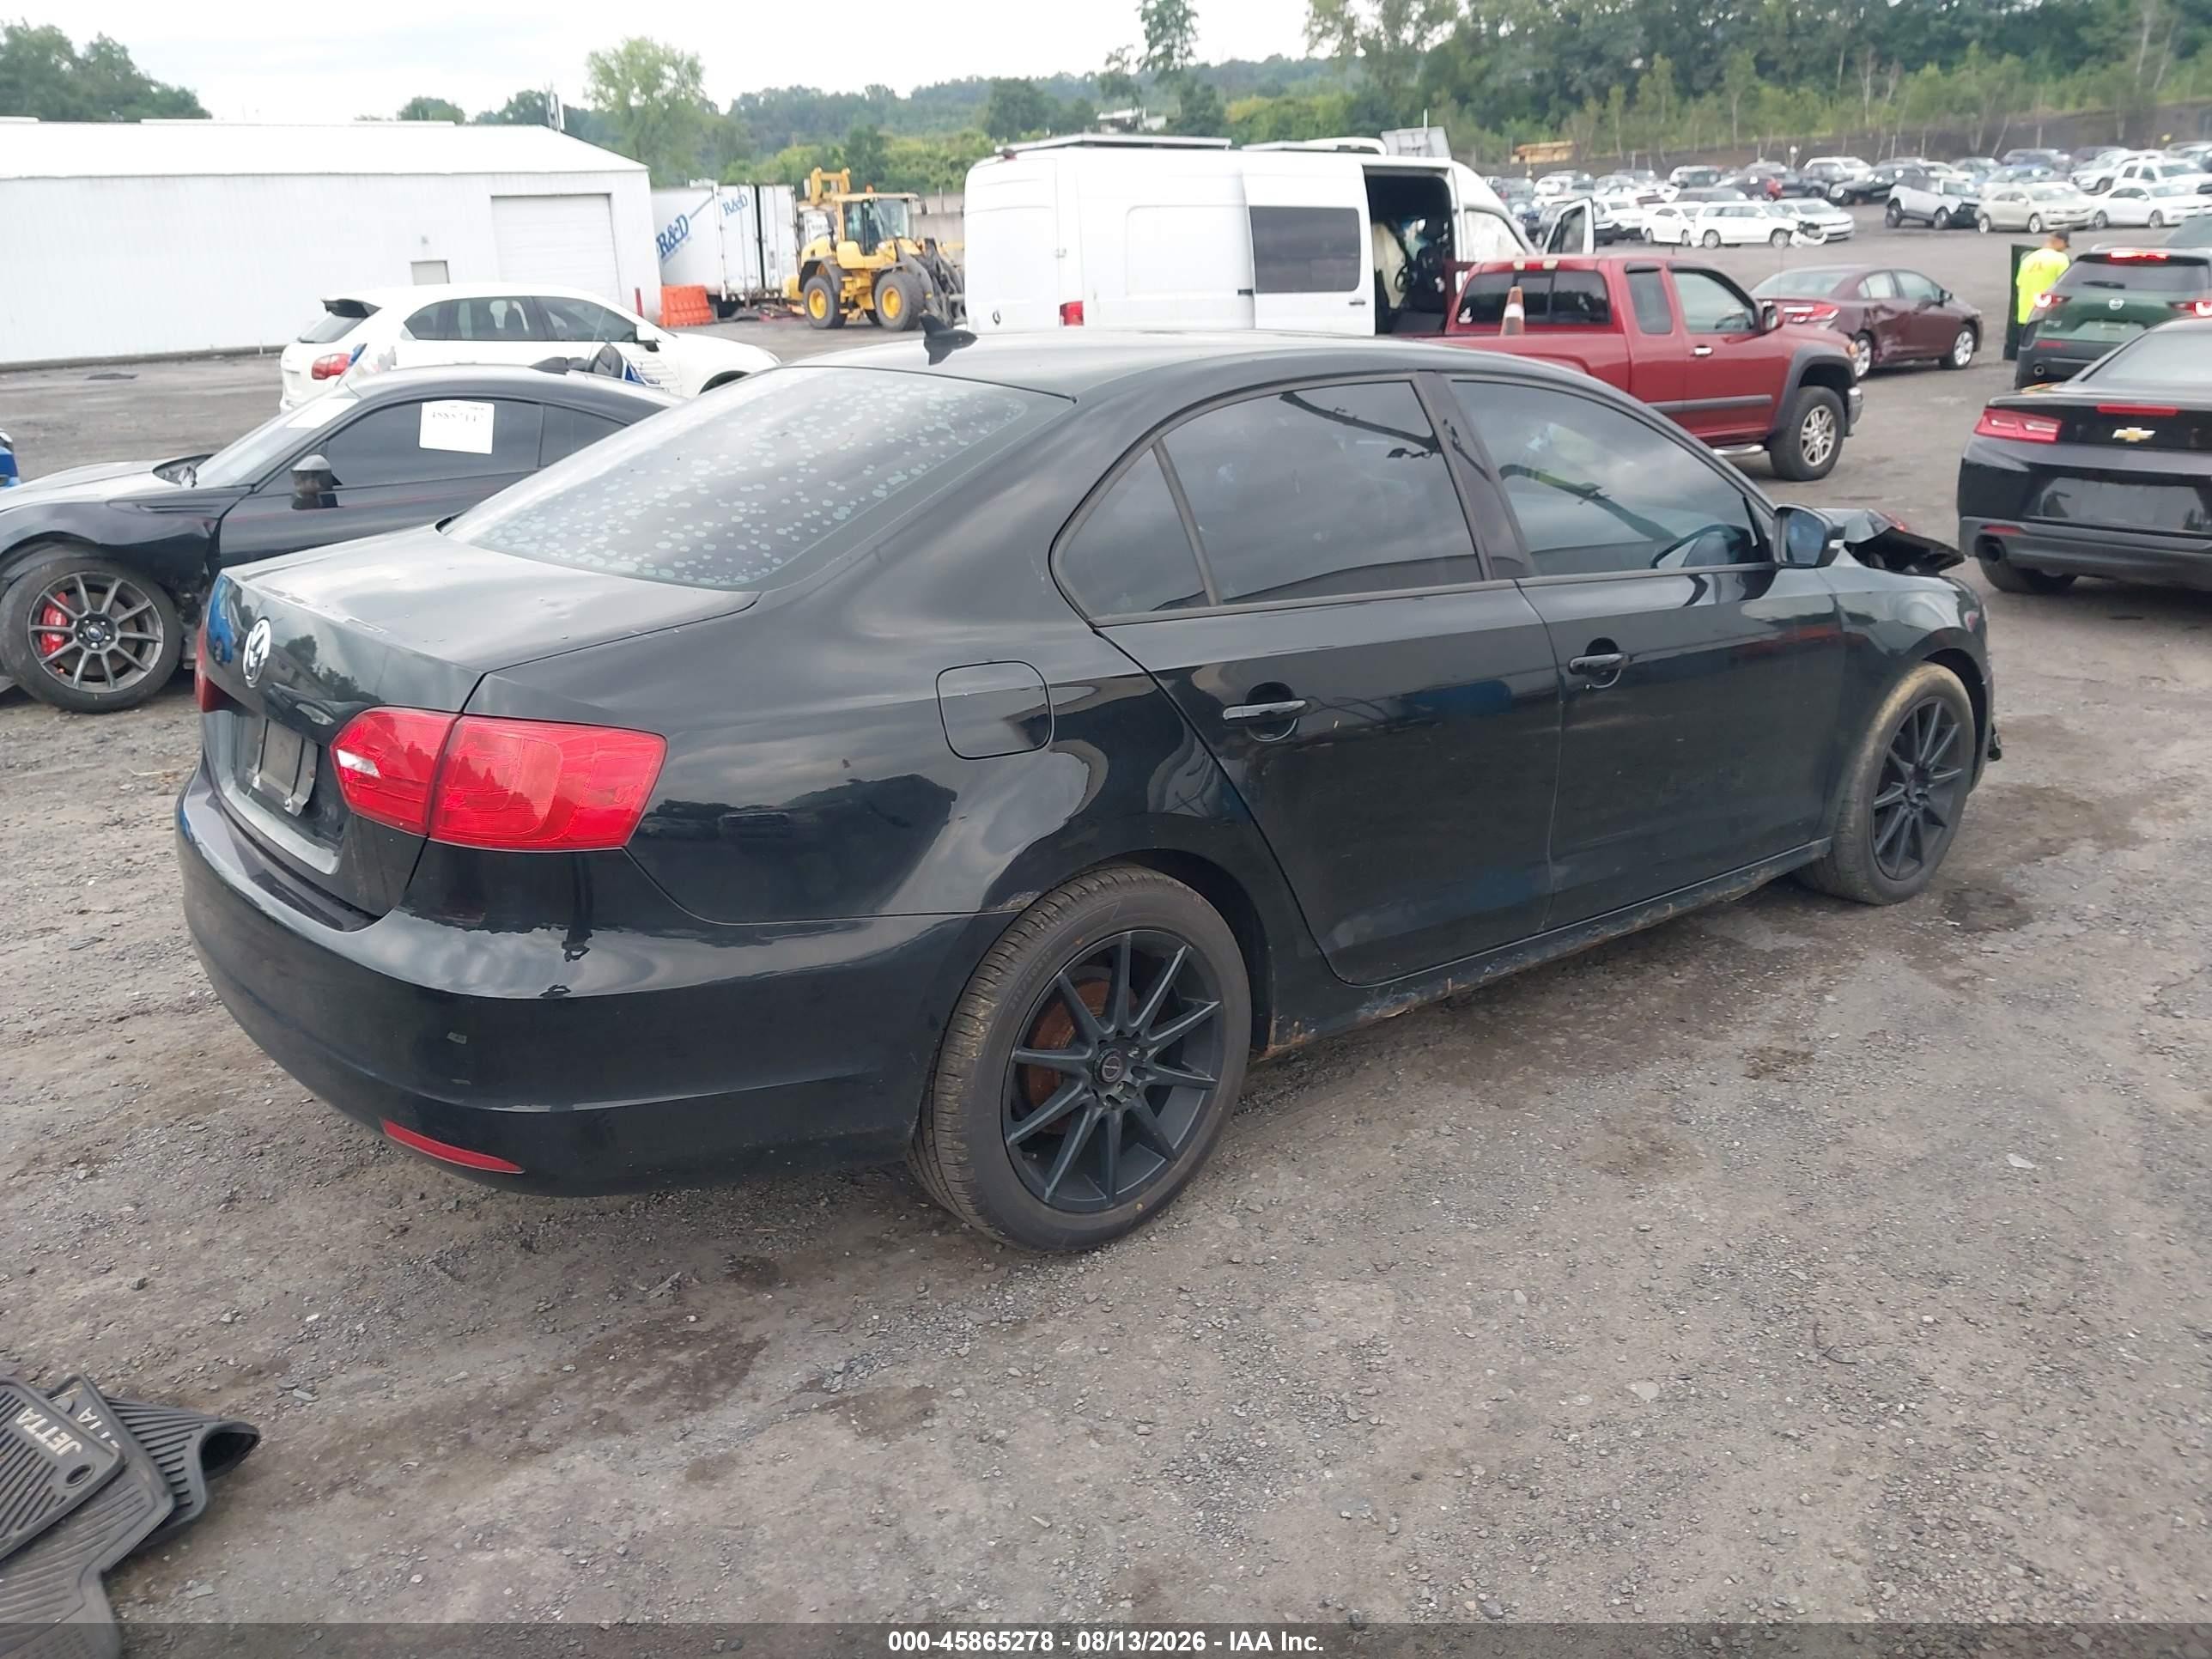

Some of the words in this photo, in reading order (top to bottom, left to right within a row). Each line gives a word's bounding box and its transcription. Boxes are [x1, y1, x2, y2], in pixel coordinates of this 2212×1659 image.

[722, 194, 748, 216] R&D
[656, 214, 689, 258] R&D
[15, 1407, 82, 1455] JETTA
